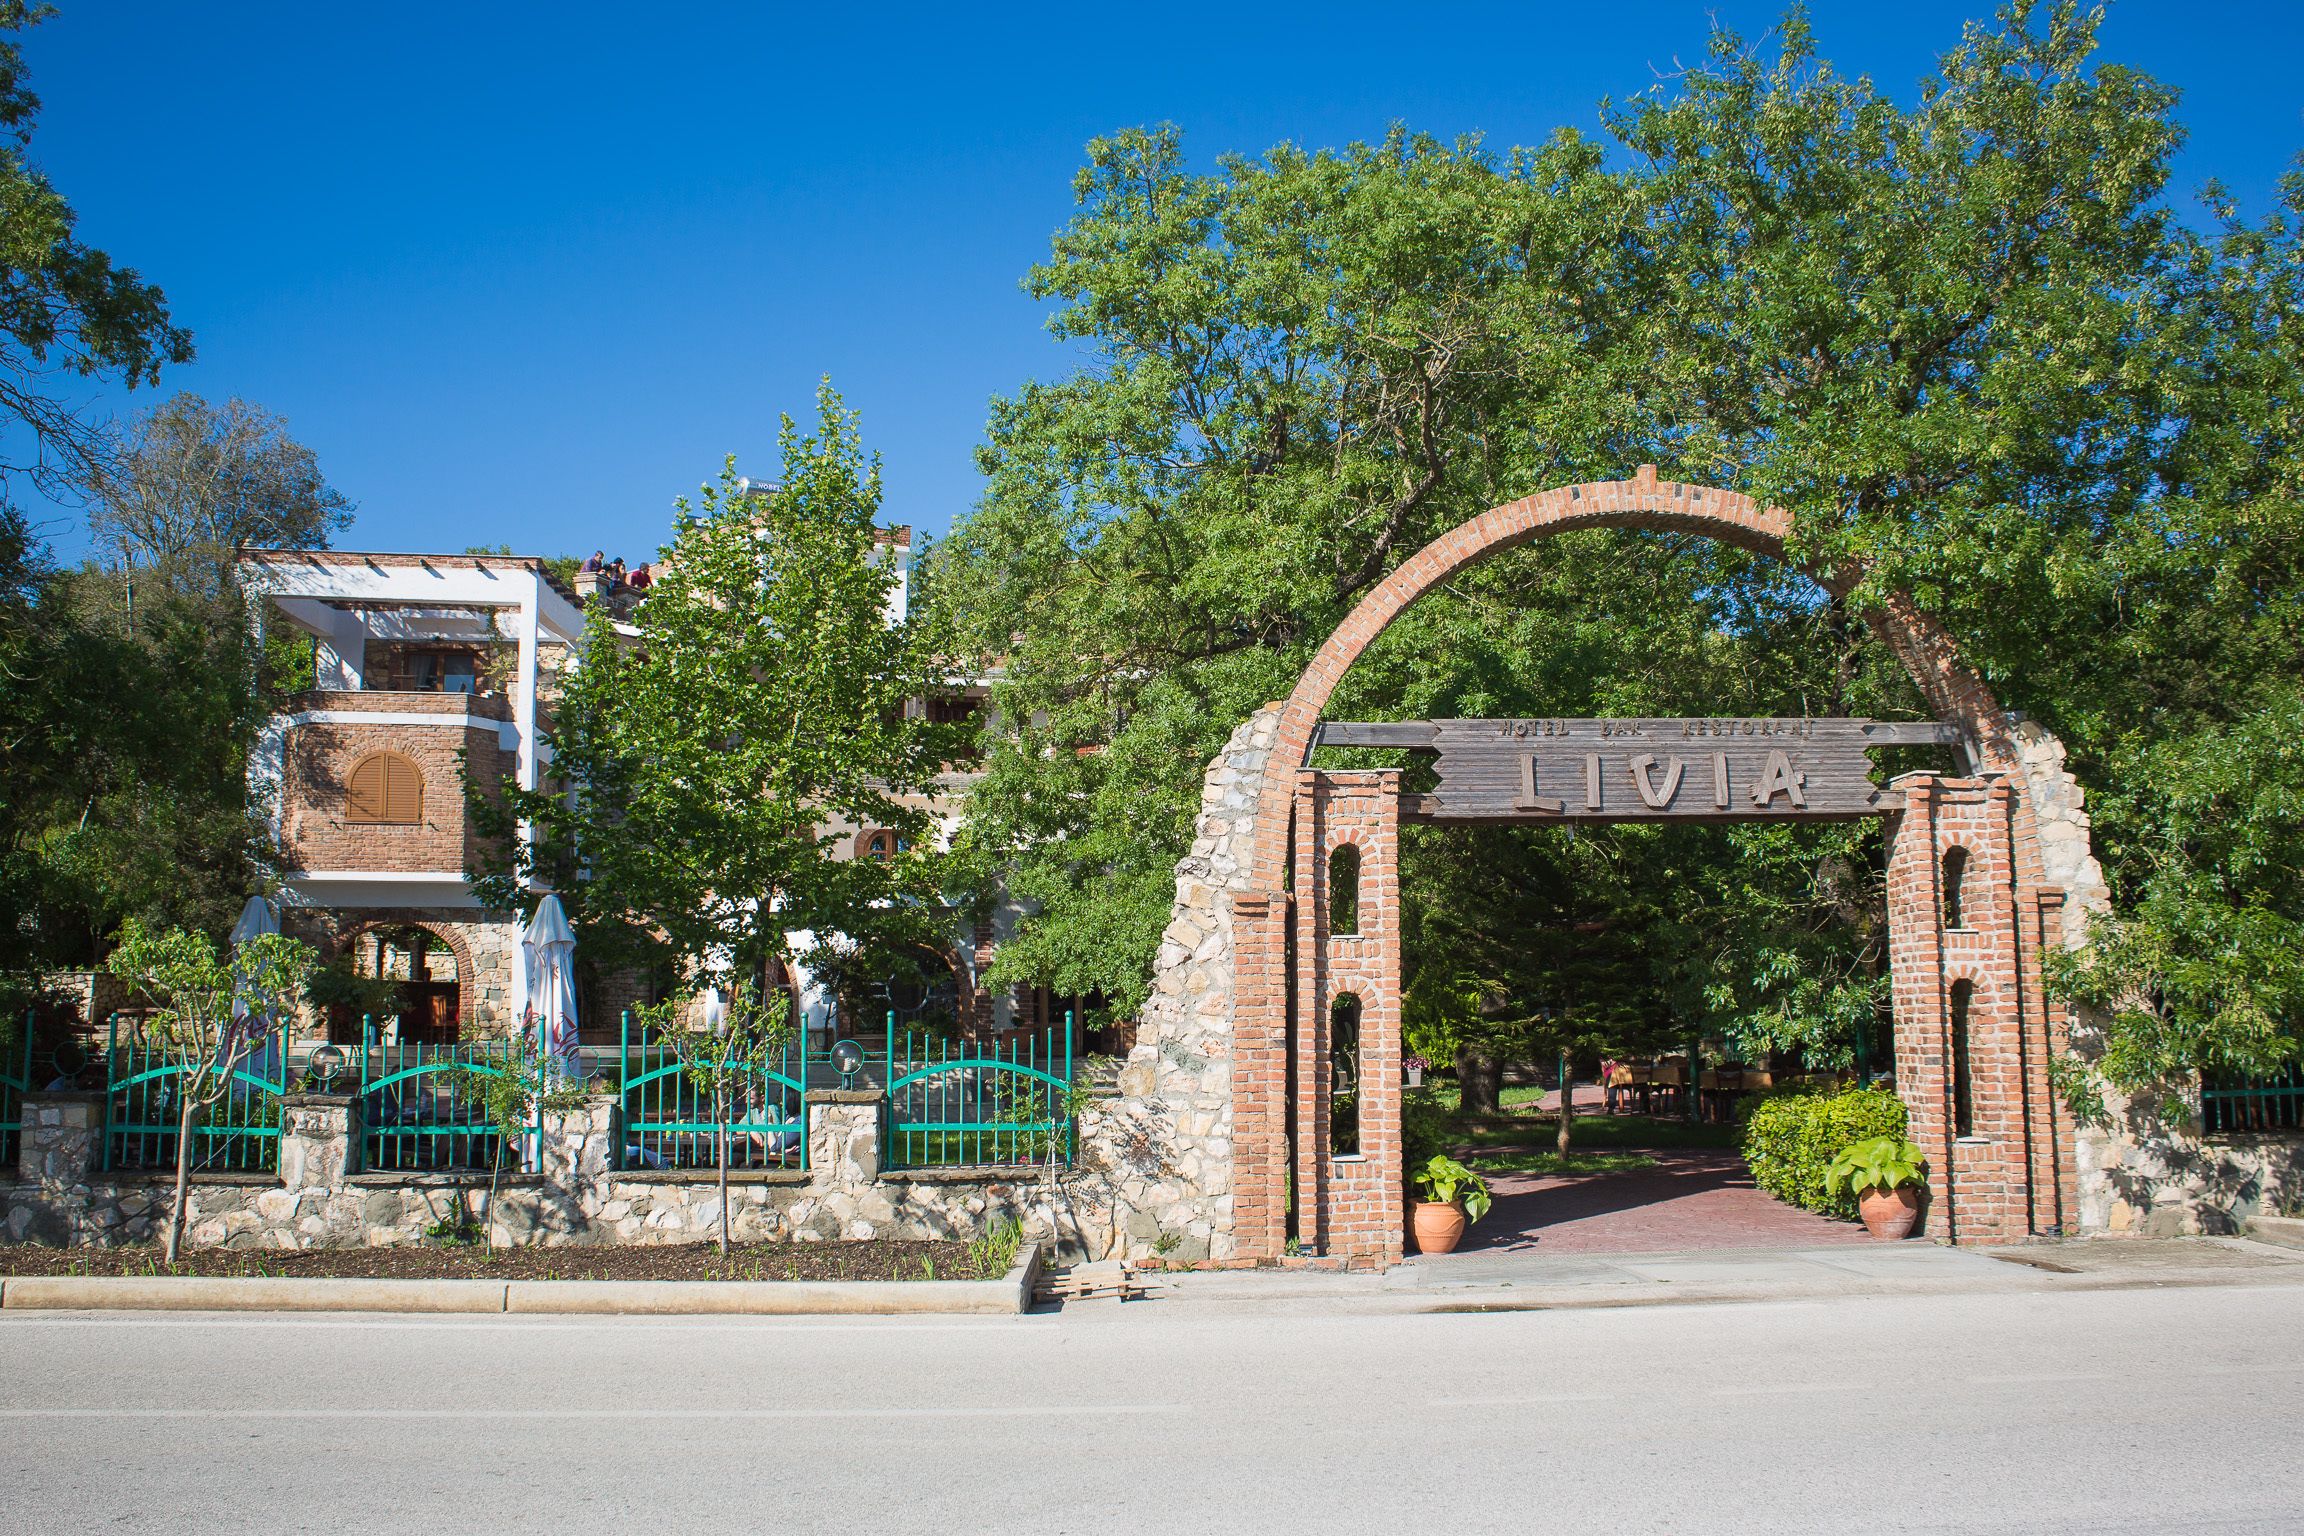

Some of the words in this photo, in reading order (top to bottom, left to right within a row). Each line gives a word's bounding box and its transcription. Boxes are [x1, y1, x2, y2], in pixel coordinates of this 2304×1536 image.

[1501, 719, 1569, 737] HOTEL
[1600, 719, 1642, 736] BAR
[1682, 719, 1815, 736] RESTORANT
[1512, 750, 1806, 811] LIVIA
